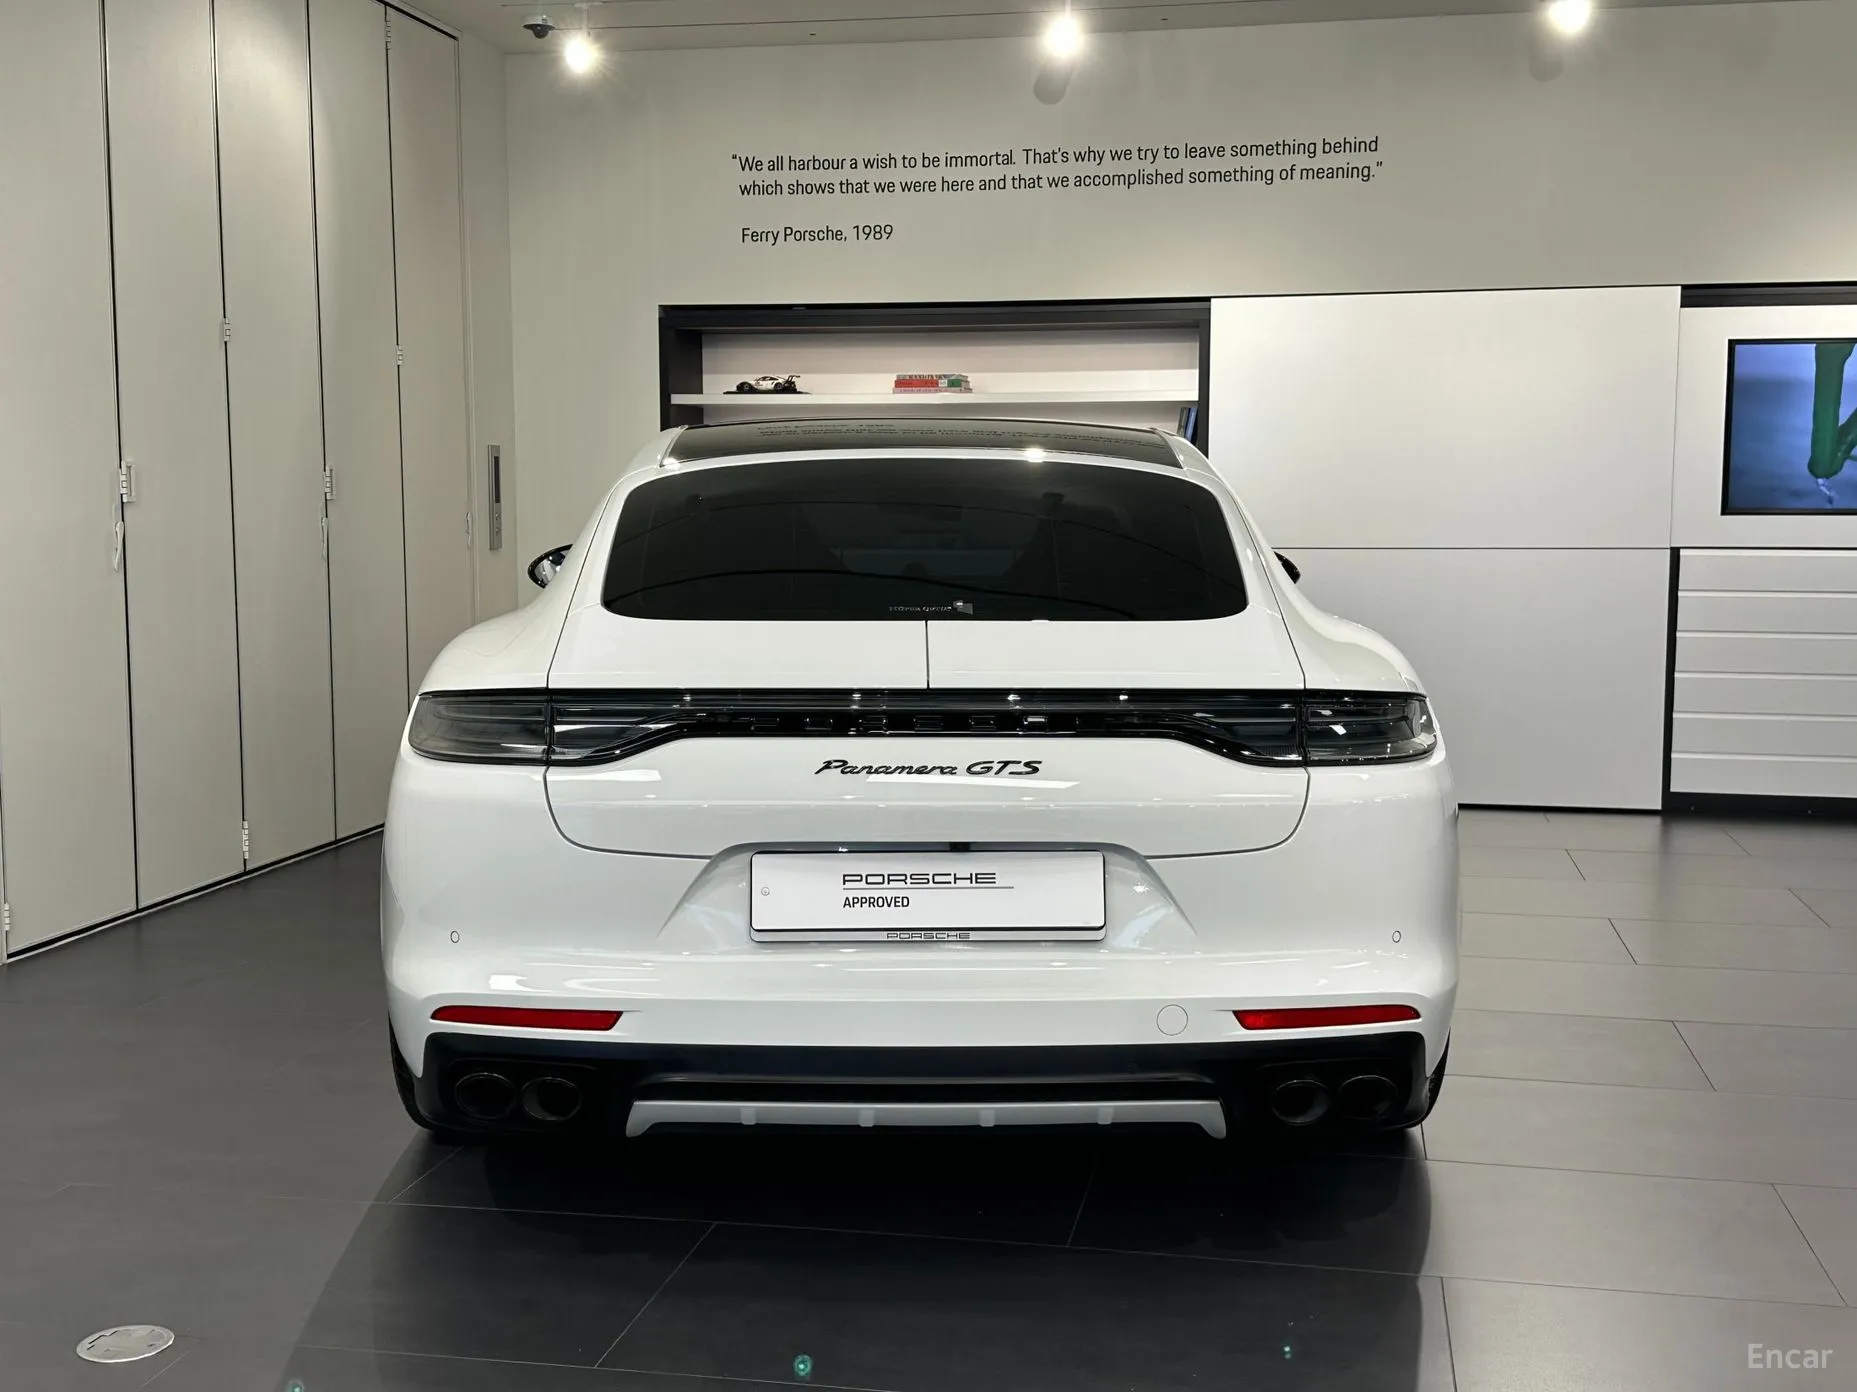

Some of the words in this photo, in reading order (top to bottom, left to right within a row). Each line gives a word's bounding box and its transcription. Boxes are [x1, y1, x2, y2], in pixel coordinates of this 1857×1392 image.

[768, 155, 783, 171] all
[789, 155, 846, 171] harbour
[850, 158, 858, 169] a
[863, 153, 897, 169] wish
[902, 155, 917, 168] to
[922, 152, 940, 168] be
[945, 149, 1016, 167] immortal.
[1022, 147, 1069, 165] That's
[1073, 146, 1105, 166] why
[1110, 149, 1132, 161] we
[1137, 146, 1159, 164] try
[1164, 145, 1179, 159] to
[1185, 143, 1225, 159] leave
[1231, 139, 1316, 159] something
[1323, 136, 1378, 154] behind
[739, 179, 783, 196] which
[788, 179, 835, 195] shows
[839, 179, 870, 194] that
[874, 182, 895, 193] we
[900, 181, 936, 192] were
[942, 176, 974, 192] here
[979, 174, 1006, 190] and
[1011, 173, 1043, 189] that
[1047, 176, 1069, 188] we
[1074, 168, 1183, 189] accomplished
[1189, 165, 1274, 185] something
[1279, 164, 1296, 180] of
[742, 228, 780, 246] Ferry
[784, 225, 847, 242] Porsche,
[853, 224, 893, 240] 1989
[814, 759, 958, 775] Panamera
[965, 760, 1042, 775] GTS
[842, 873, 996, 885] PORSCHE
[843, 896, 910, 908] APPROVED
[886, 932, 971, 940] PORSCHE
